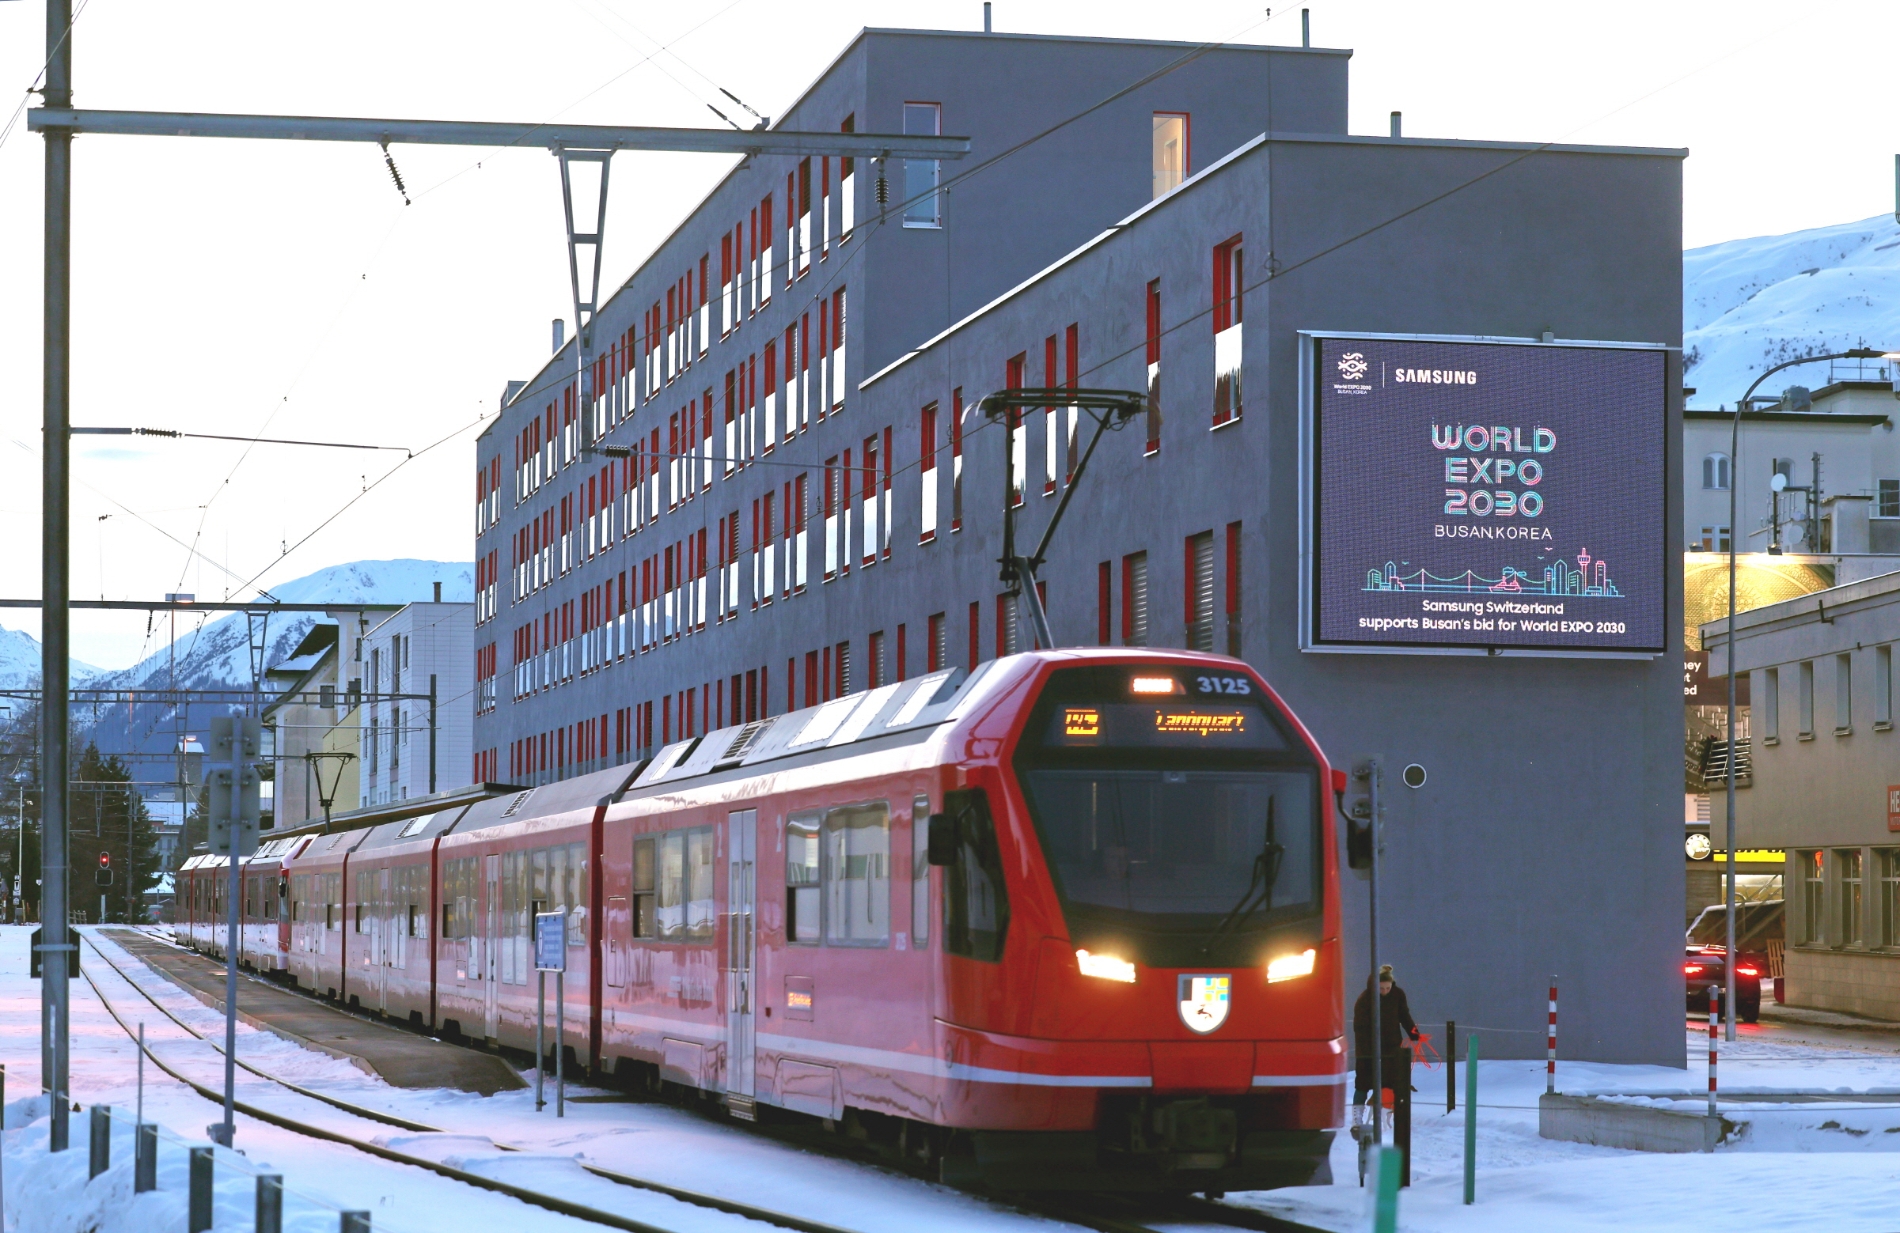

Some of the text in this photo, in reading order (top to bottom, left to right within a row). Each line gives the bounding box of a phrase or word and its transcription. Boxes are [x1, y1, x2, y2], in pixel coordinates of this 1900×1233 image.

[1395, 368, 1477, 385] SAMSUNG
[1432, 424, 1556, 452] WORLD
[1445, 457, 1543, 486] EXPO
[1444, 489, 1544, 517] 2030
[1496, 526, 1553, 540] KOREA
[1422, 599, 1564, 616] Samsung Switzerland
[1359, 617, 1626, 634] supports Busan's bid for World EXPO 2030
[1197, 676, 1251, 695] 3125
